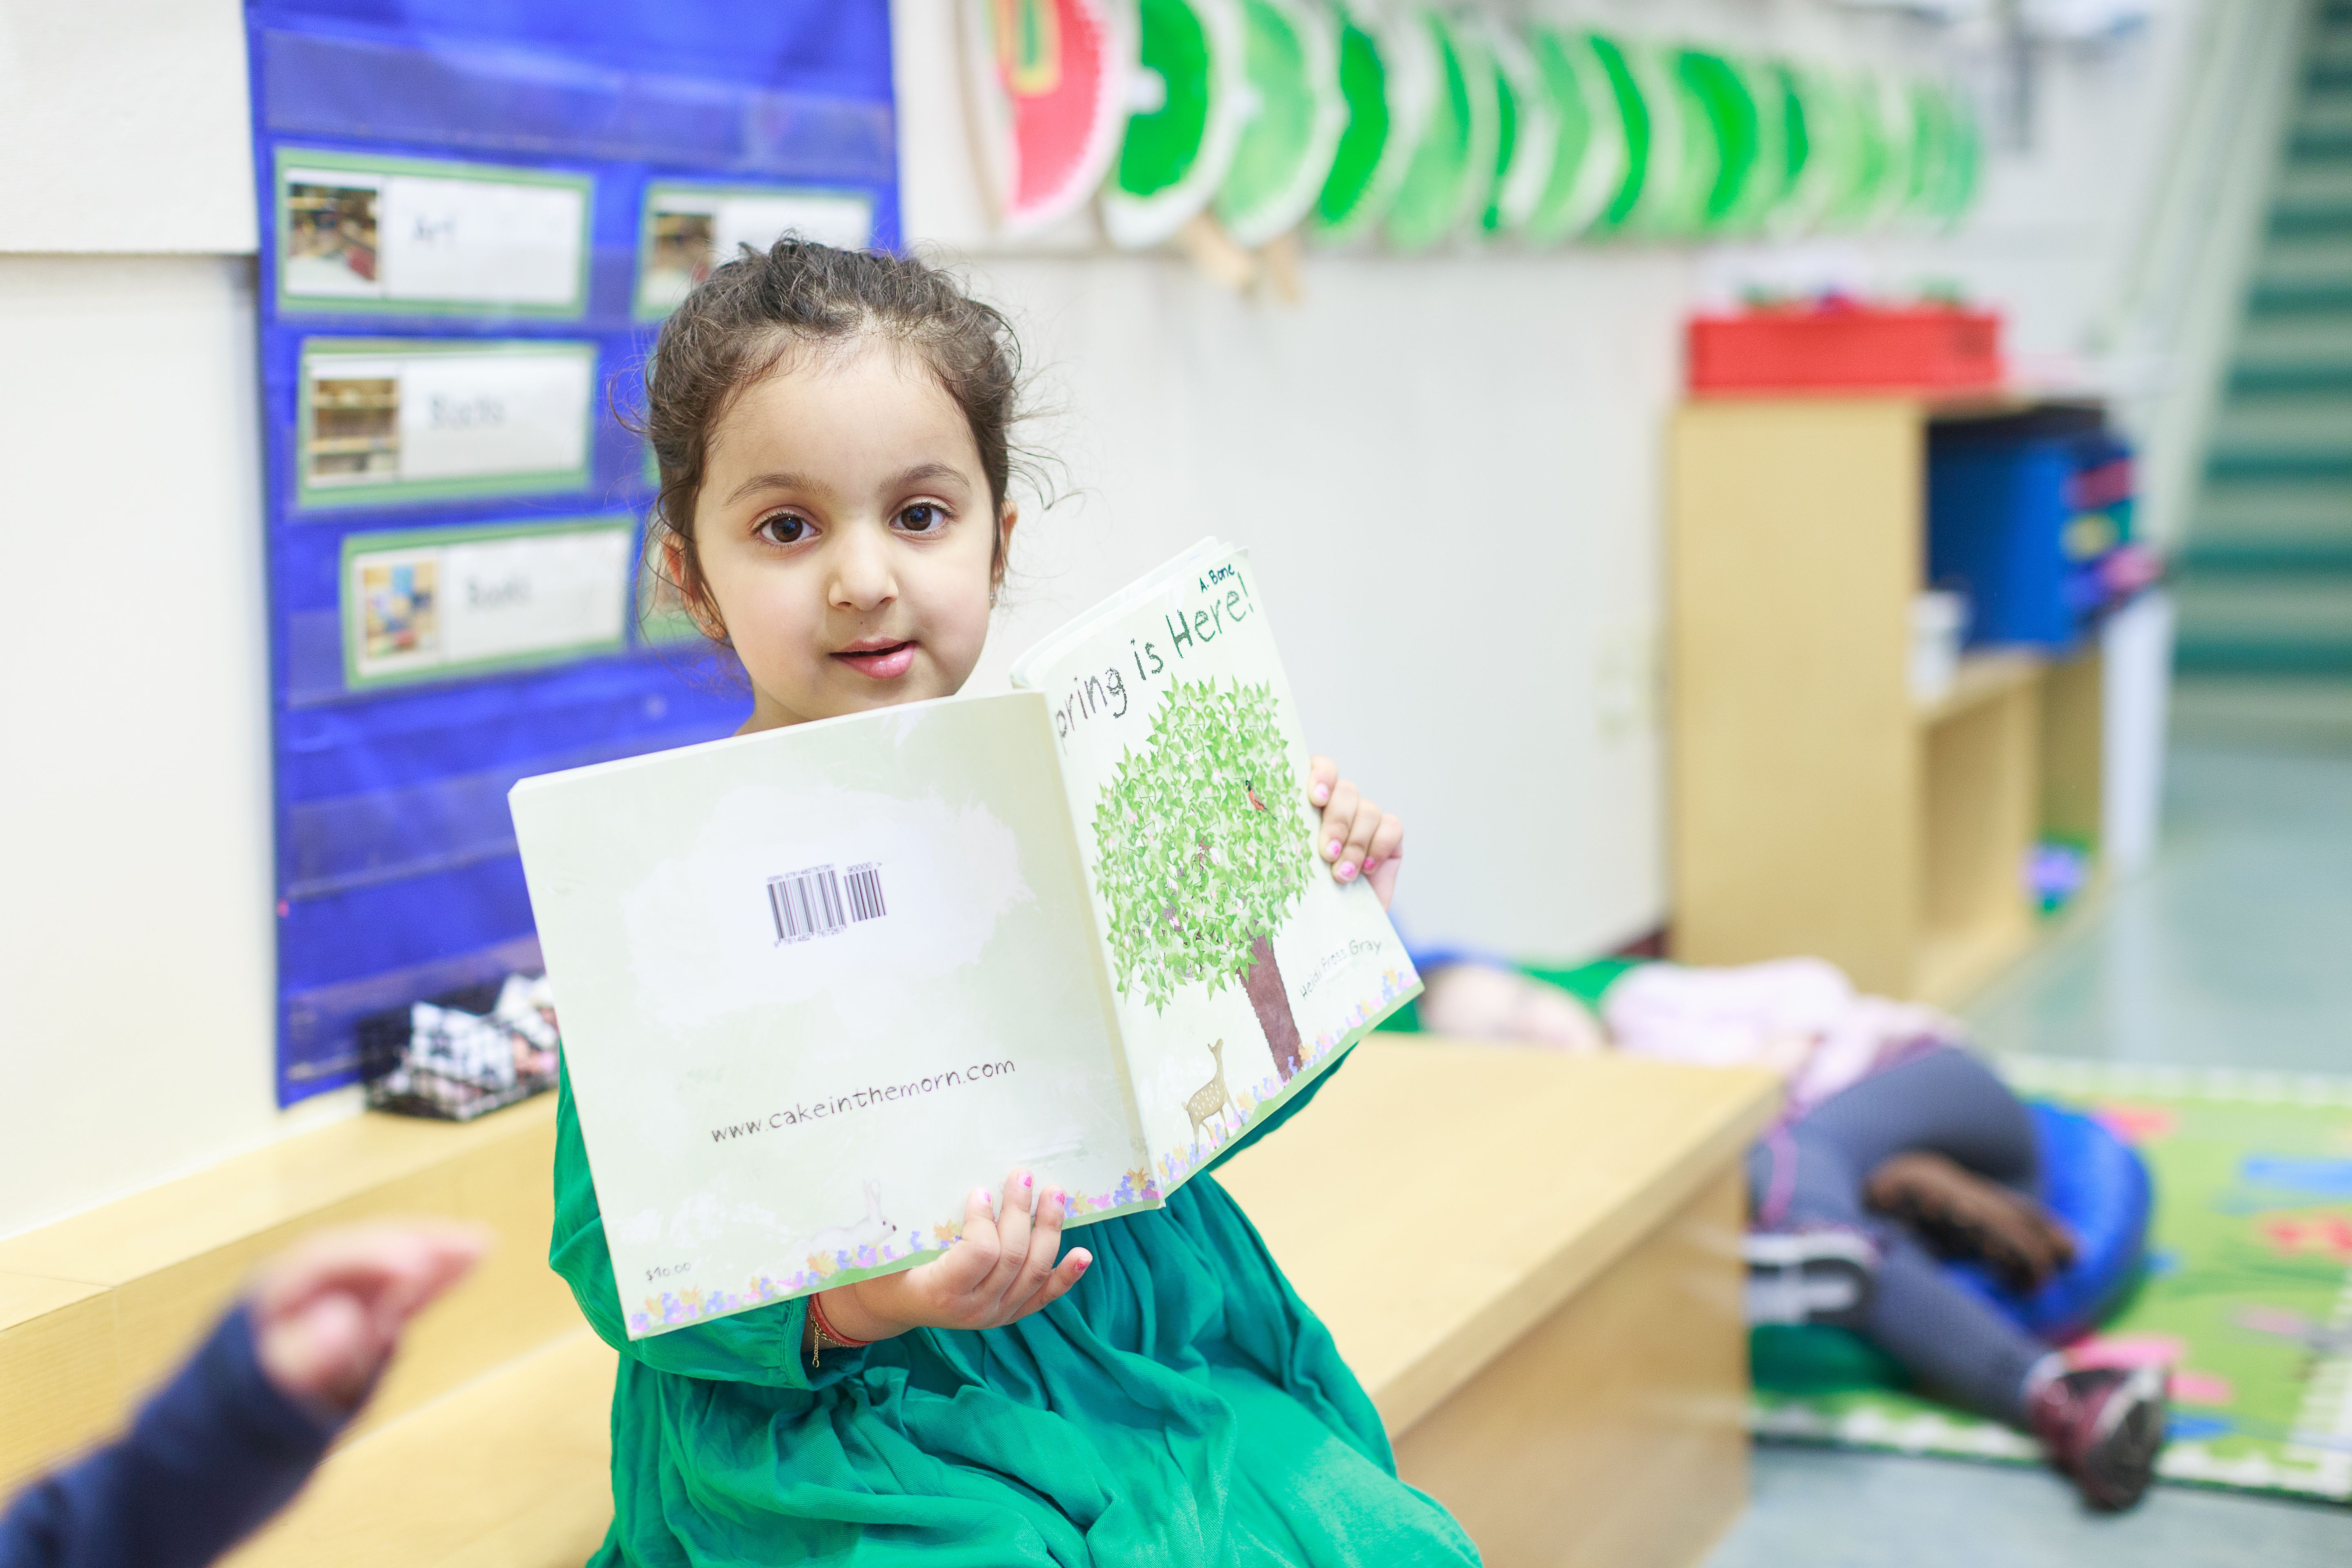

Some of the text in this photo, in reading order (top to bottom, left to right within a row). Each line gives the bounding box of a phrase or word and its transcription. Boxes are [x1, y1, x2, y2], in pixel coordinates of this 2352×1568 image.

[1199, 577, 1209, 593] A.
[1055, 572, 1254, 757] pring is Here!
[1300, 966, 1322, 1001] Heidi
[1349, 939, 1381, 956] Gray
[711, 1060, 1015, 1143] www.cakeinthemorn.com
[646, 1262, 691, 1283] $10.00
